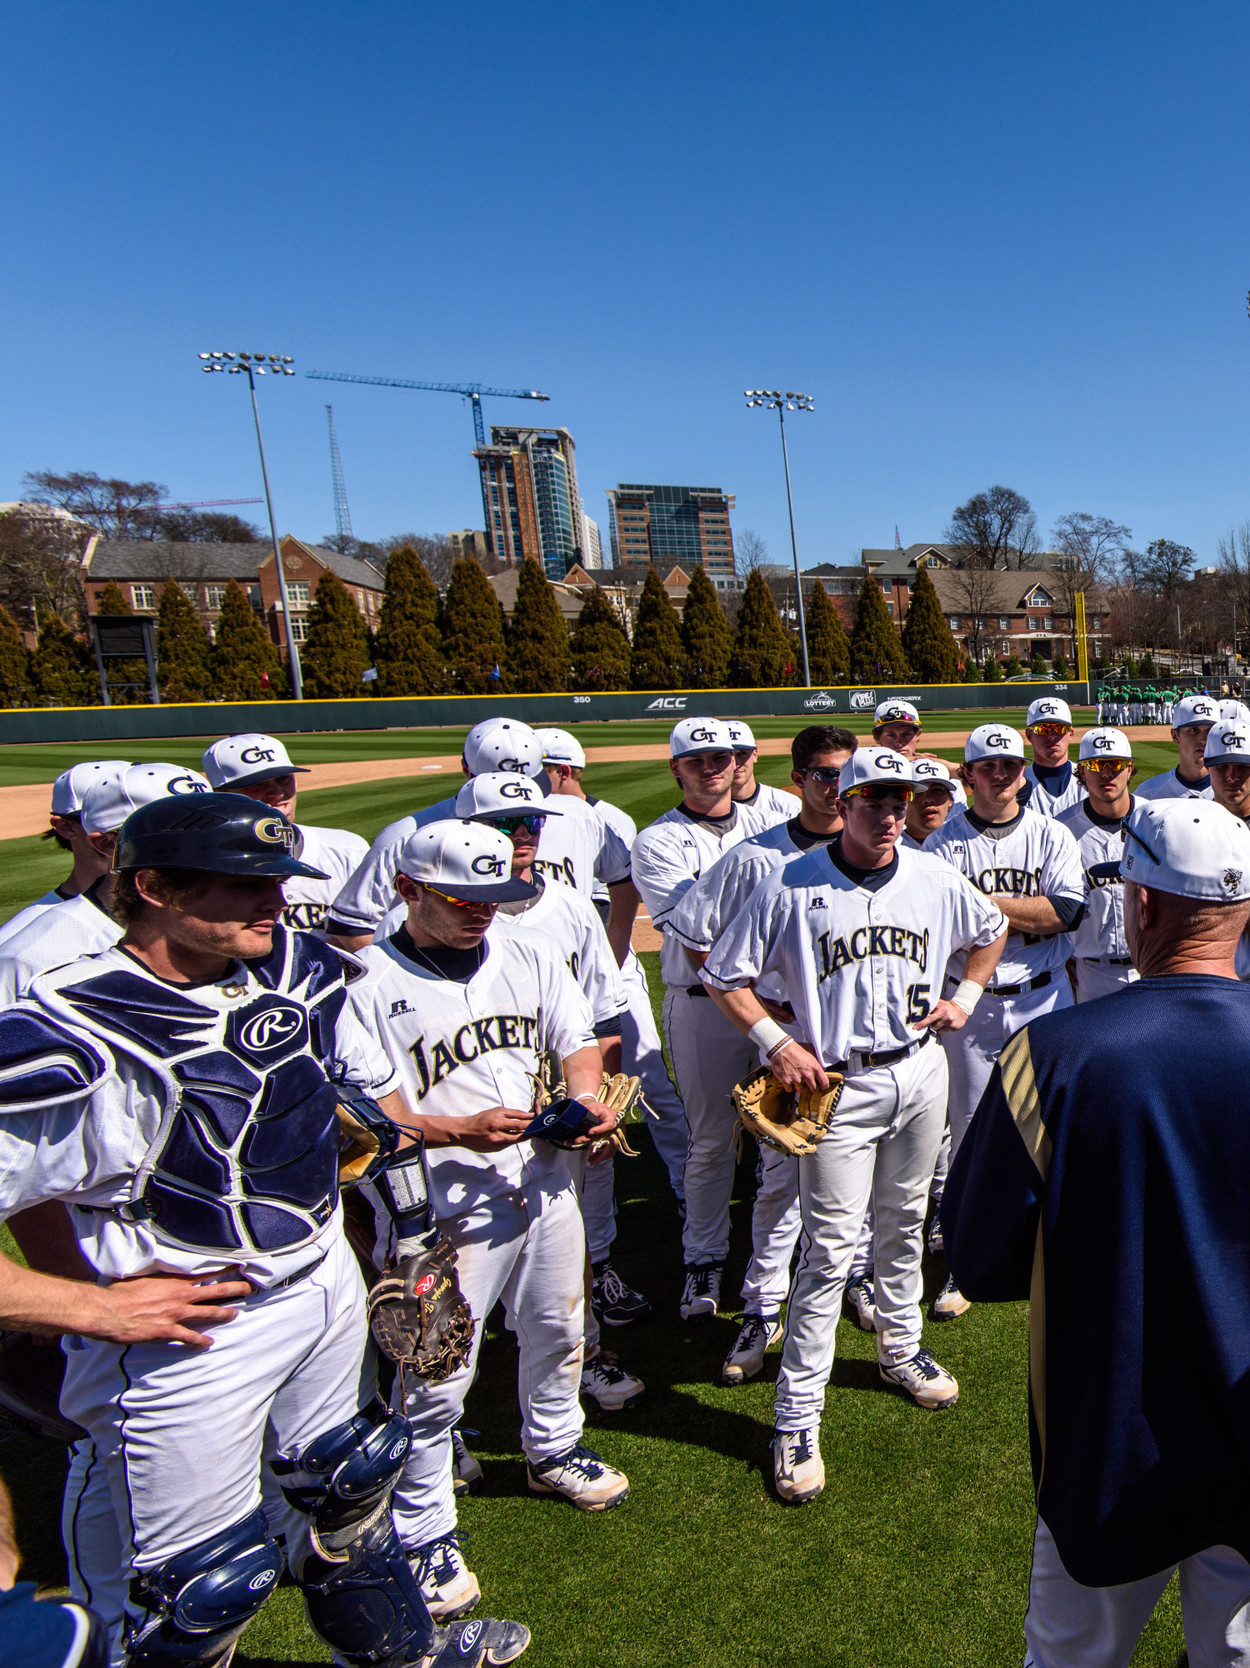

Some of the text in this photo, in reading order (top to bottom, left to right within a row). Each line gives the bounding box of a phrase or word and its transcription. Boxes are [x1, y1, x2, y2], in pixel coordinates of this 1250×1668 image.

[647, 697, 688, 709] ACC
[1038, 702, 1059, 715] GT
[1192, 702, 1213, 717] GT
[690, 727, 717, 743] GT
[728, 727, 742, 741] T
[986, 733, 1012, 749] GT
[1220, 731, 1246, 748] GT
[1092, 736, 1115, 751] GT
[240, 746, 275, 764] GT
[875, 754, 904, 774] GT
[915, 763, 939, 777] GT
[500, 782, 532, 801] GT
[253, 817, 294, 848] GT
[471, 854, 506, 877] GT
[817, 925, 930, 984] JACKETS
[391, 999, 408, 1013] R
[905, 983, 931, 1025] 15
[250, 1011, 293, 1047] R
[431, 1276, 452, 1301] Georgia
